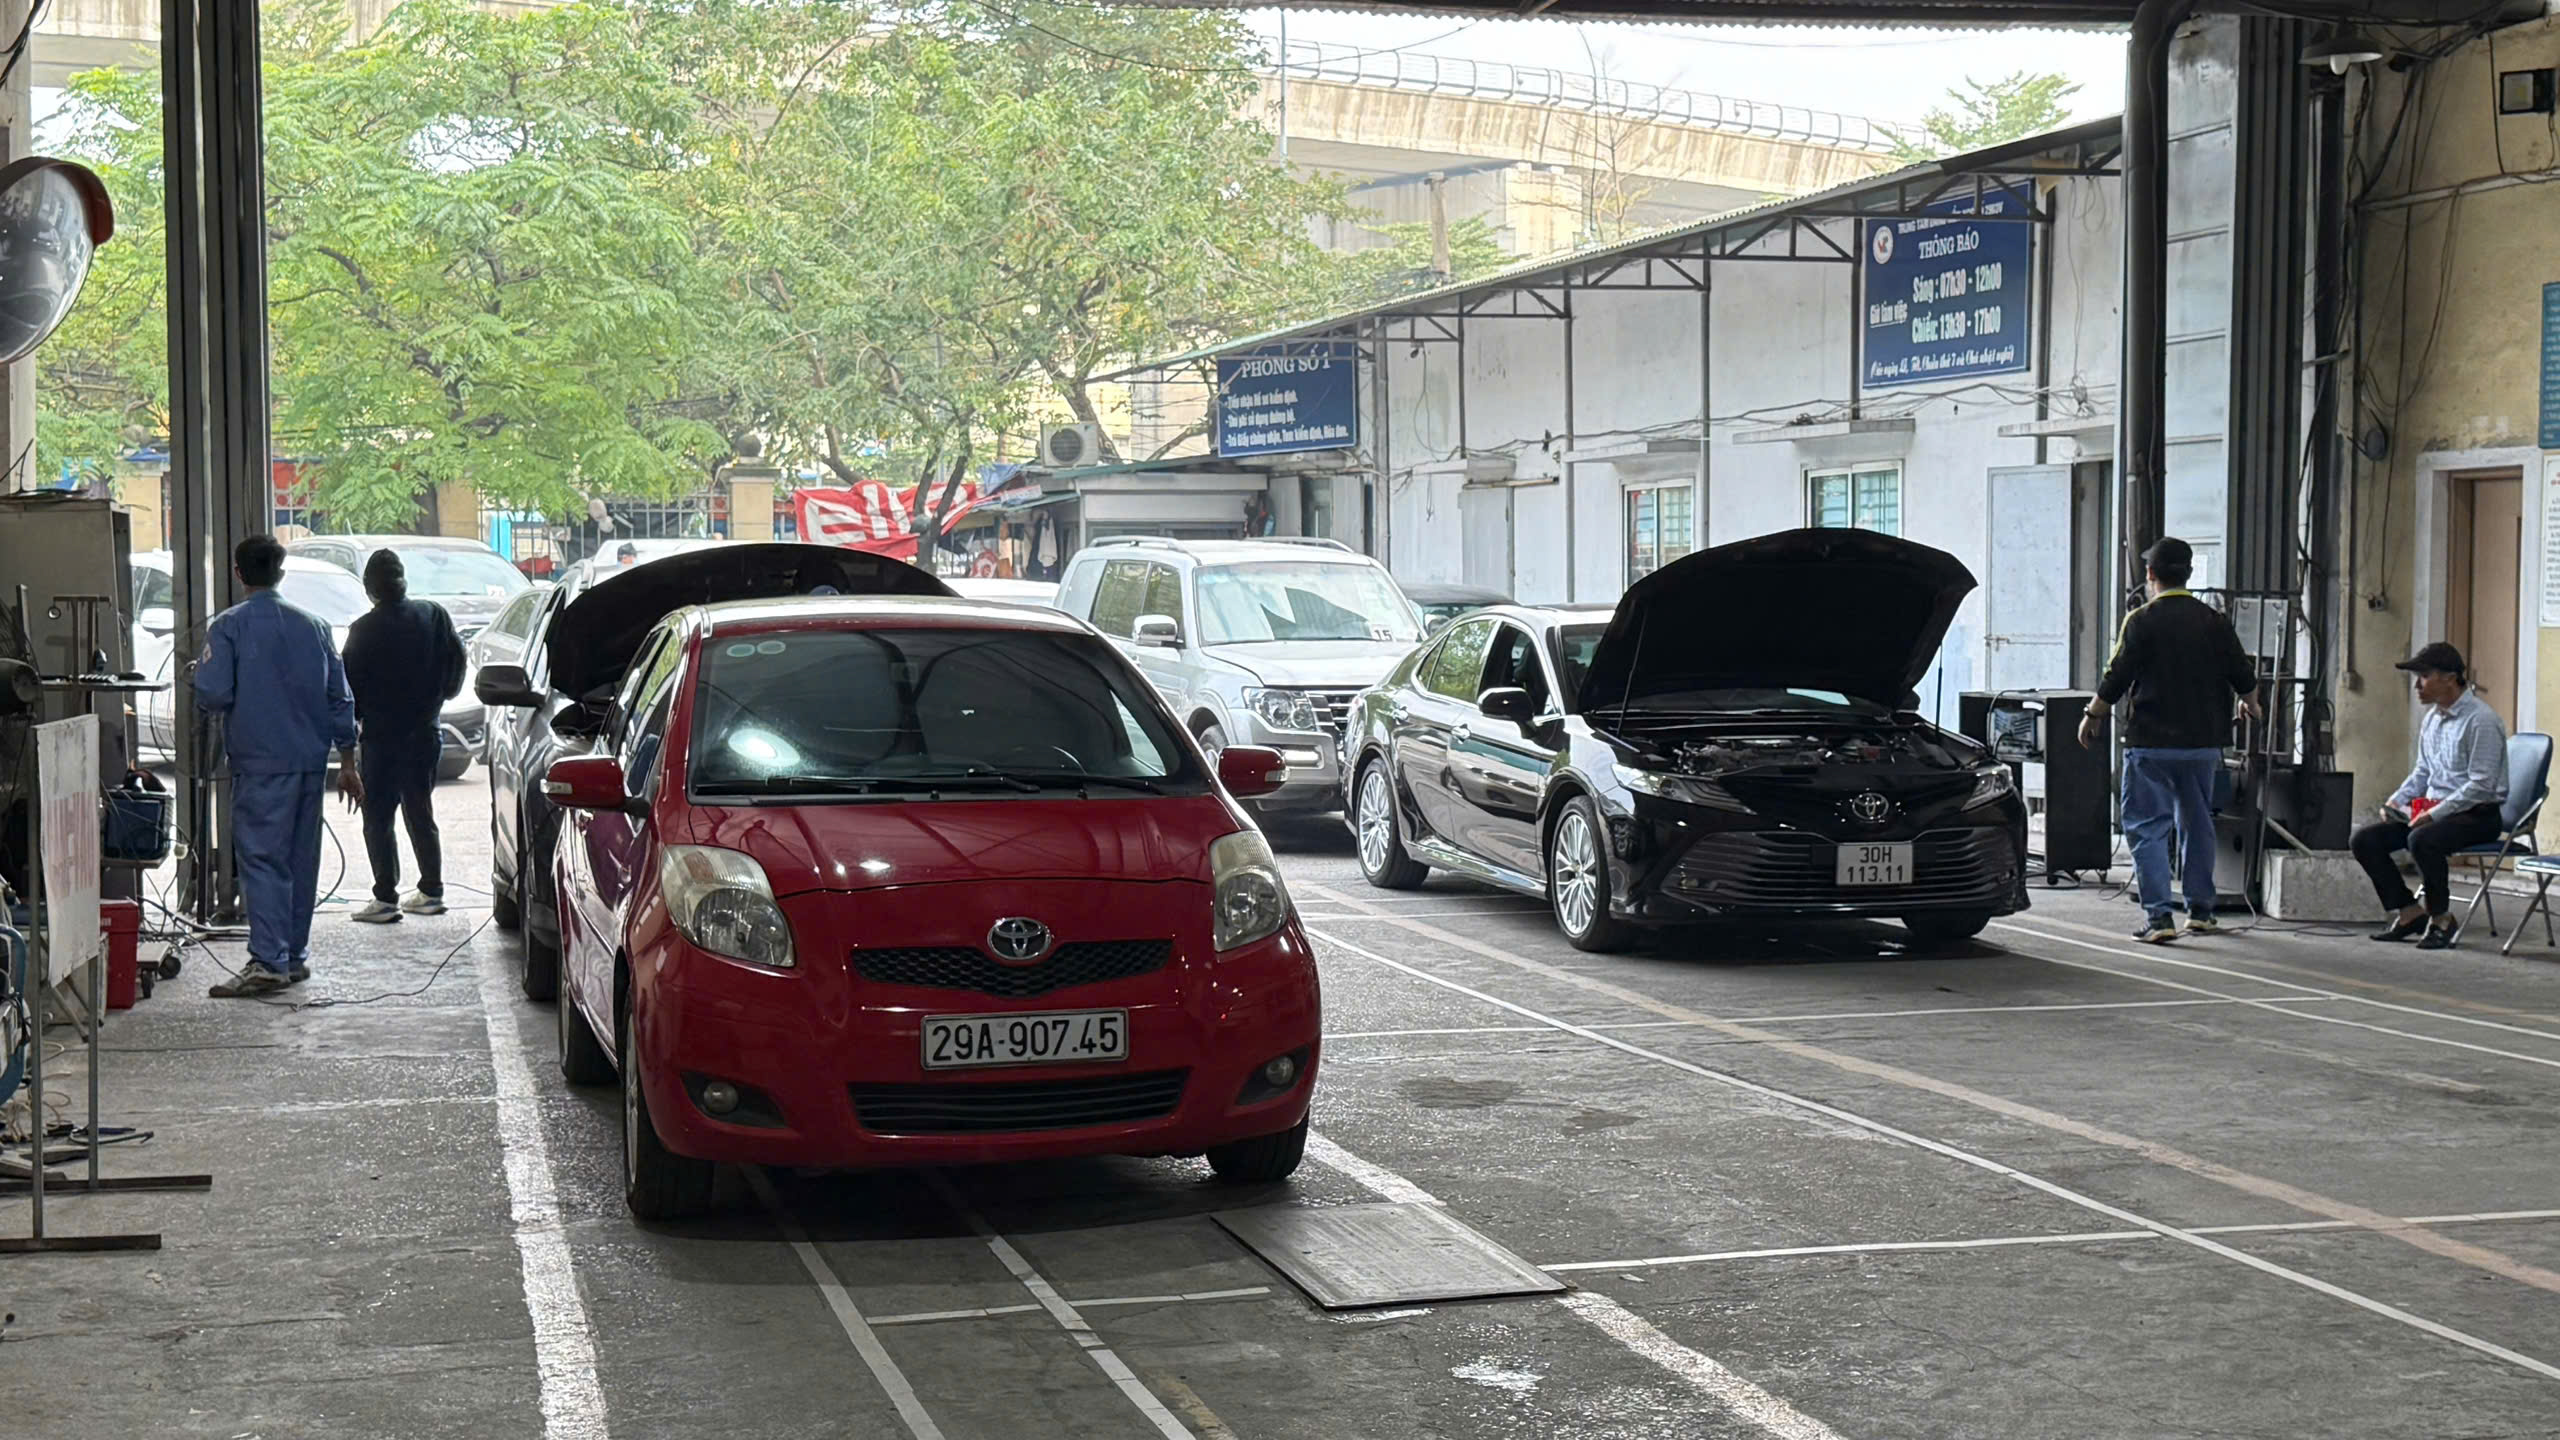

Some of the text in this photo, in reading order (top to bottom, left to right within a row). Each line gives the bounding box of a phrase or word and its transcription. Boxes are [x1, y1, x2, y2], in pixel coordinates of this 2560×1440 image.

[1919, 233, 1954, 259] THÔNG
[1957, 226, 1979, 252] BÁO
[1940, 268, 1966, 299] 07h30
[1975, 262, 2002, 292] 12h00
[1940, 311, 1966, 340] 13h30
[1974, 306, 2001, 336] 17h00
[1298, 344, 1319, 372] SỐ
[1322, 351, 1330, 369] 1
[1860, 846, 1892, 863] 30H
[1848, 865, 1903, 882] 113.11
[932, 1017, 1118, 1061] 29A-907.45
